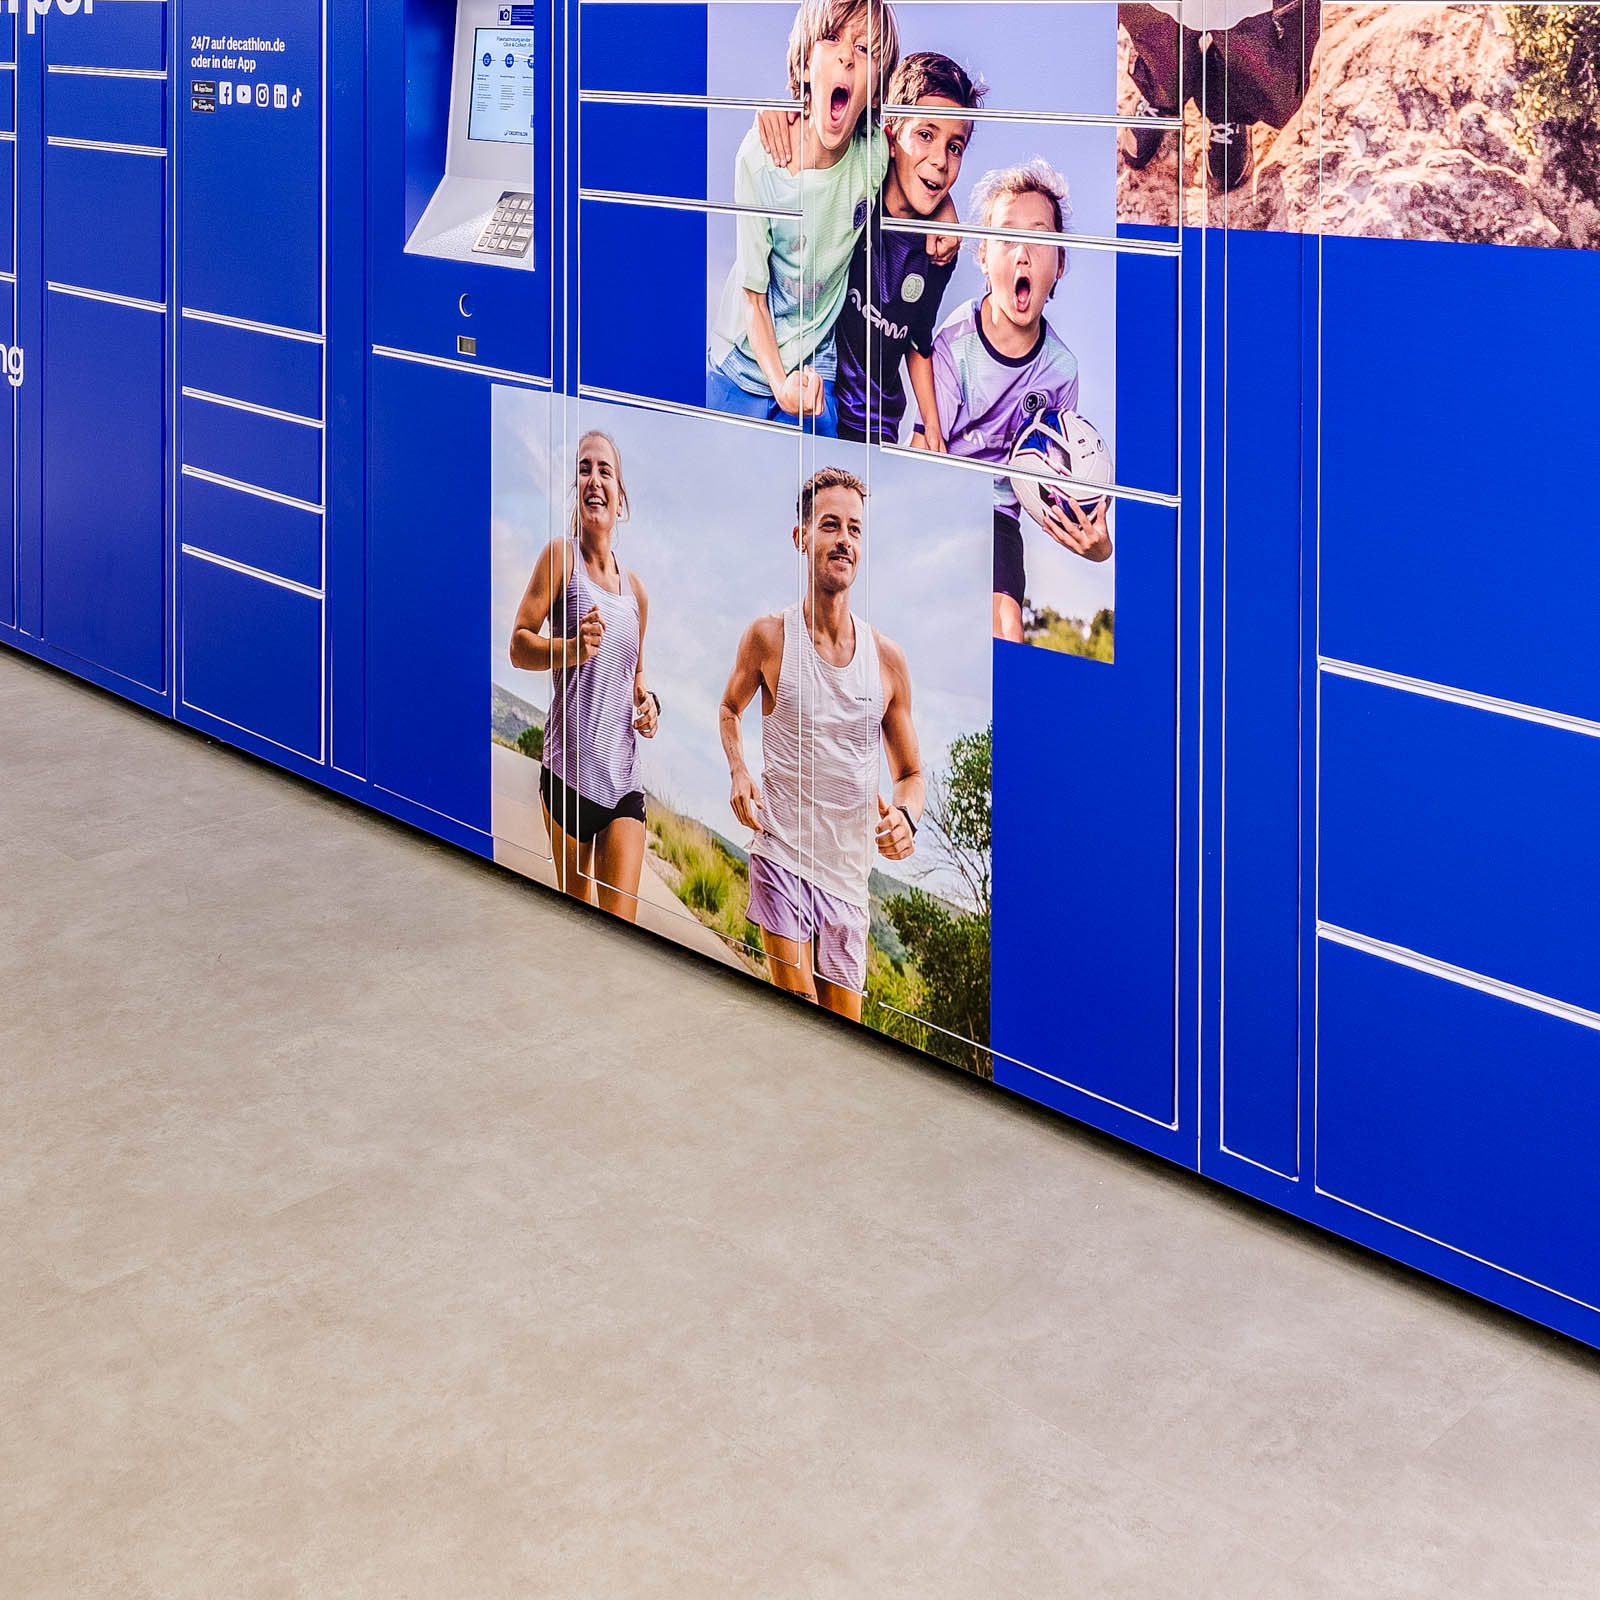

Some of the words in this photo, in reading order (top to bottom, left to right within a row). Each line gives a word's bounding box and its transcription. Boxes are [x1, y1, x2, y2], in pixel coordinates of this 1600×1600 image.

[191, 36, 210, 51] 24/7
[211, 37, 226, 50] auf
[227, 37, 286, 52] decathlon.de
[191, 54, 211, 68] oder
[212, 55, 220, 69] in
[221, 56, 236, 69] der
[238, 56, 256, 73] App
